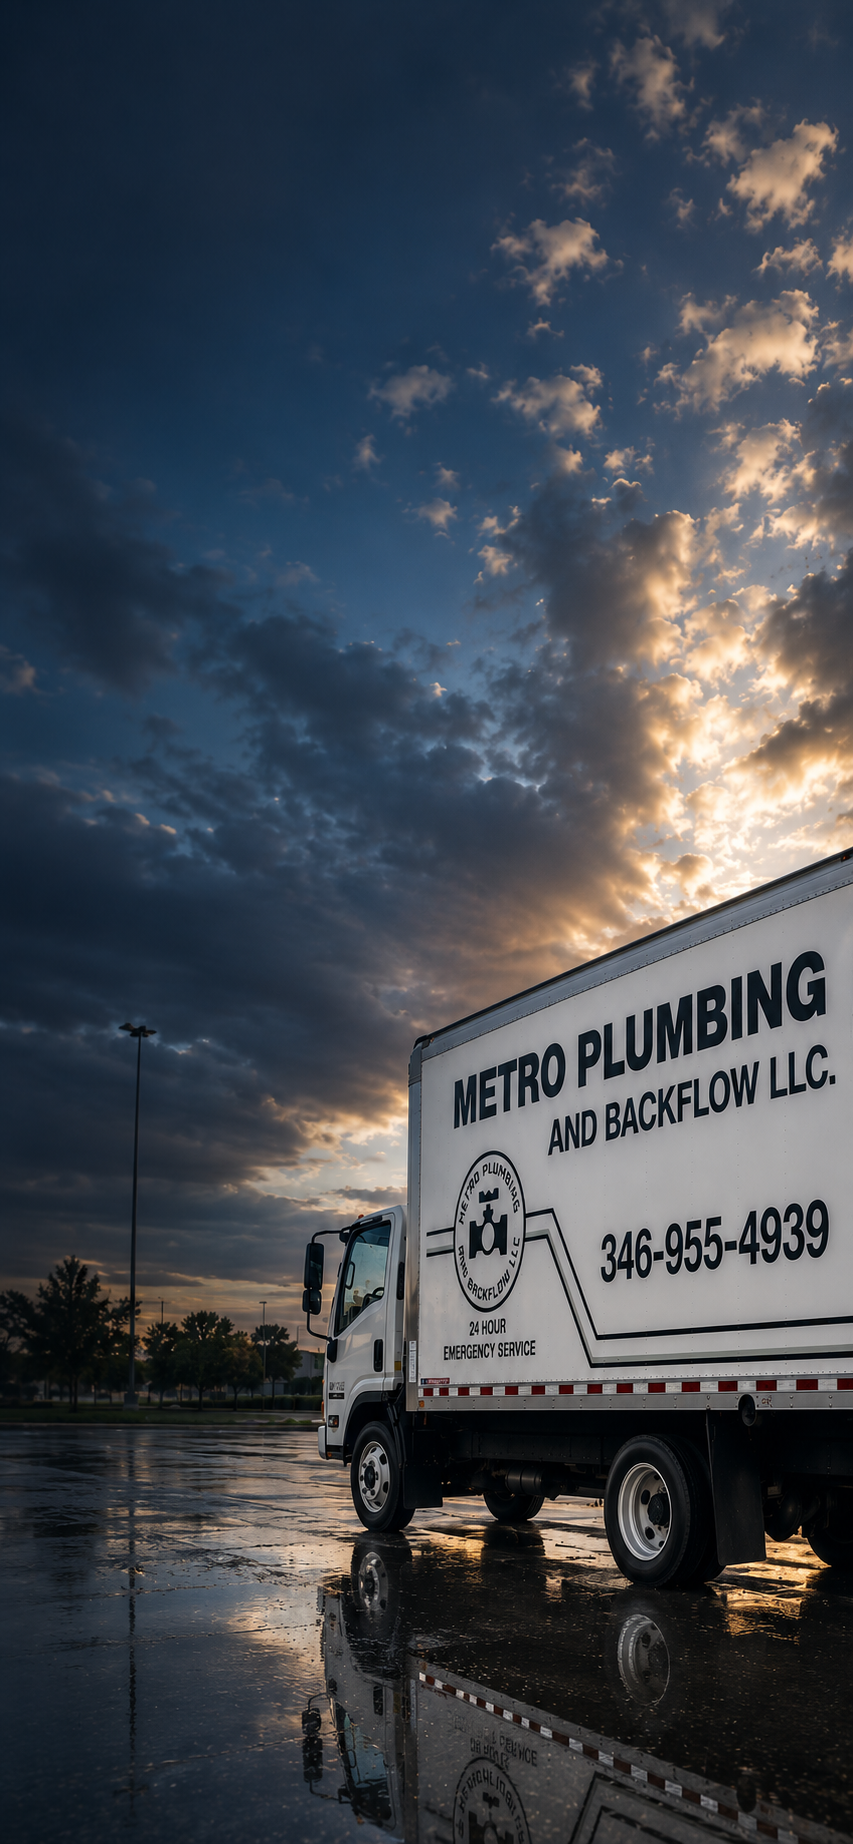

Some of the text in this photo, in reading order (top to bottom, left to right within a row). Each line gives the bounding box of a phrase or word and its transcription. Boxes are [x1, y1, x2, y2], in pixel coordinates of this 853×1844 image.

[454, 950, 827, 1130] METRO PLUMBING
[548, 1044, 836, 1156] AND BACKFLOW LLC.
[600, 1199, 829, 1283] 346-955-4939
[444, 1340, 536, 1360] EMERGENCY SERVICE
[469, 1318, 506, 1336] 24 HOUR
